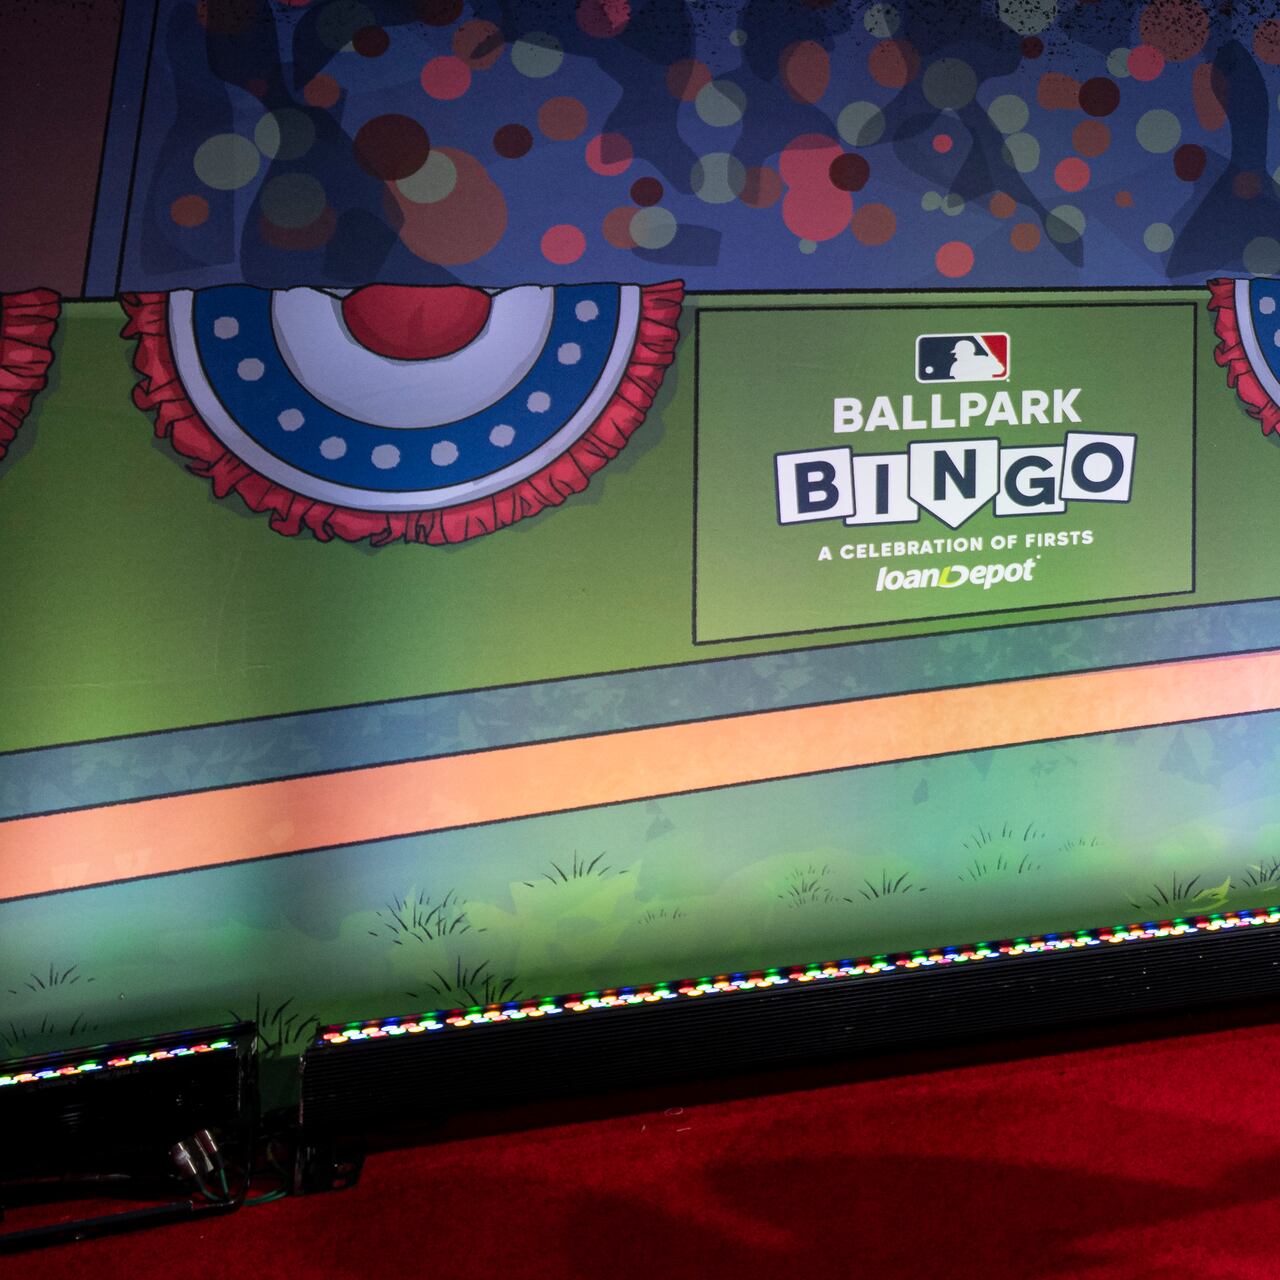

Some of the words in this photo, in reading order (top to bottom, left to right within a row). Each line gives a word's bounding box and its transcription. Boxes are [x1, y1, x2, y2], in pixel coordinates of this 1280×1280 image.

[833, 388, 1082, 433] BALLPARK
[794, 442, 1124, 515] BINGO
[818, 546, 832, 561] A
[840, 537, 983, 560] CELEBRATION
[990, 535, 1018, 550] OF
[1025, 530, 1094, 549] FIRSTS
[876, 557, 1036, 592] loanDepot
